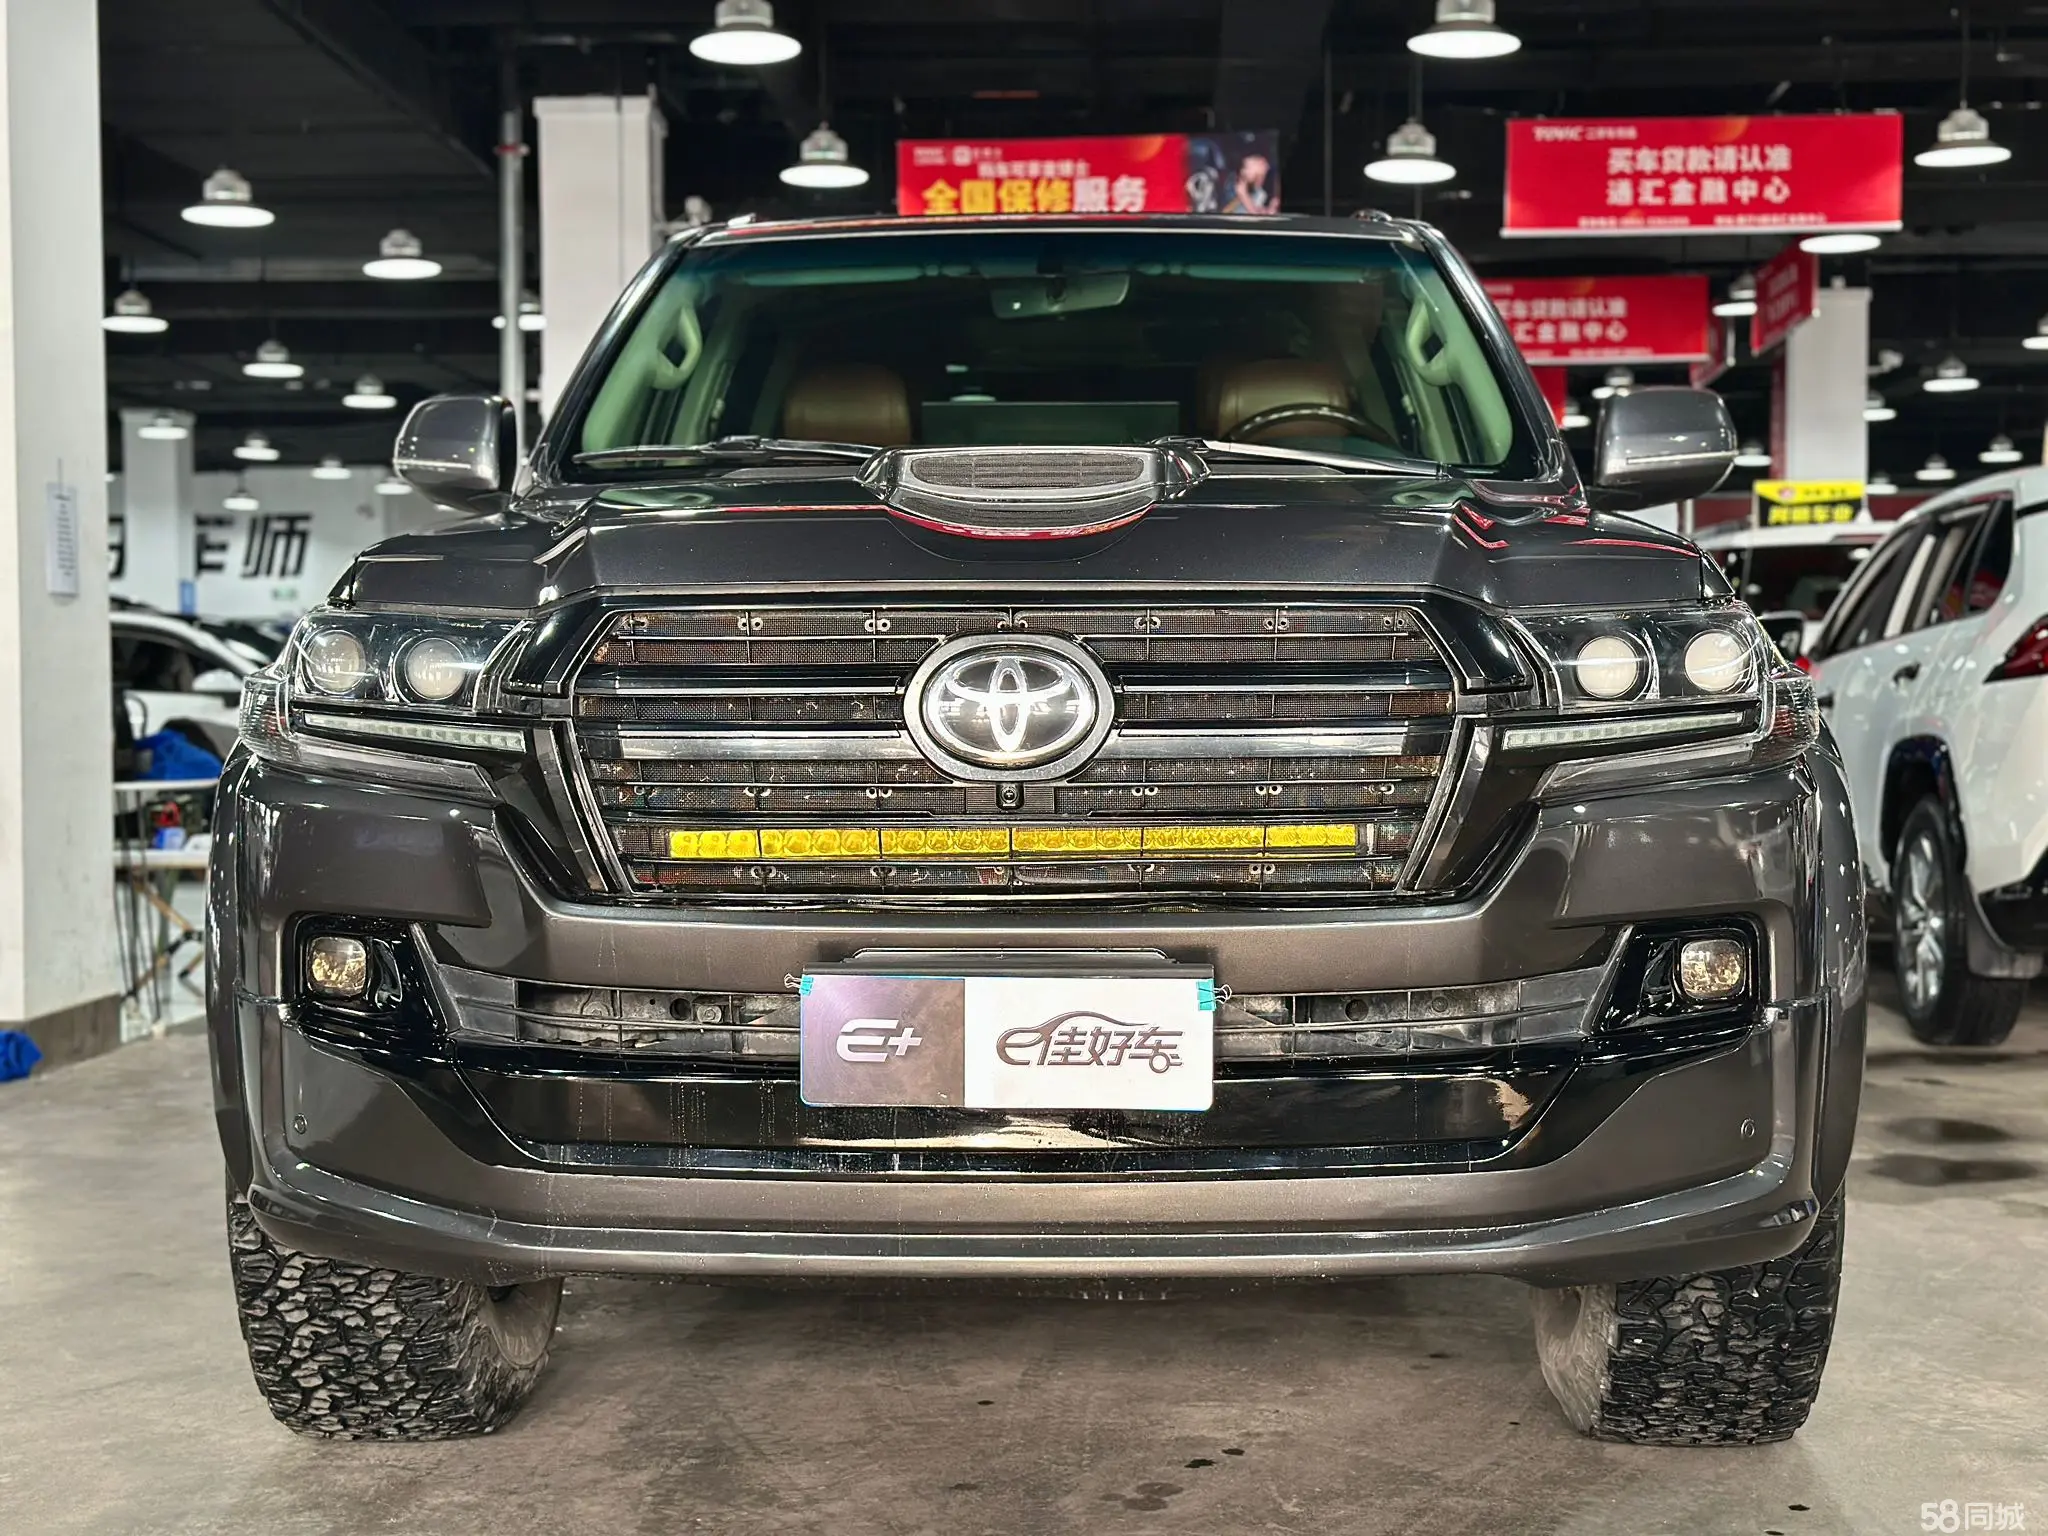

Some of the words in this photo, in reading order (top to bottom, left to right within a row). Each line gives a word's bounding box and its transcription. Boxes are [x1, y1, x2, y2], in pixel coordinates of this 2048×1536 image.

[1607, 144, 1792, 174] 买车贷款请认准
[921, 176, 1147, 214] 全国保修服务
[1606, 175, 1791, 206] 通汇金融中心
